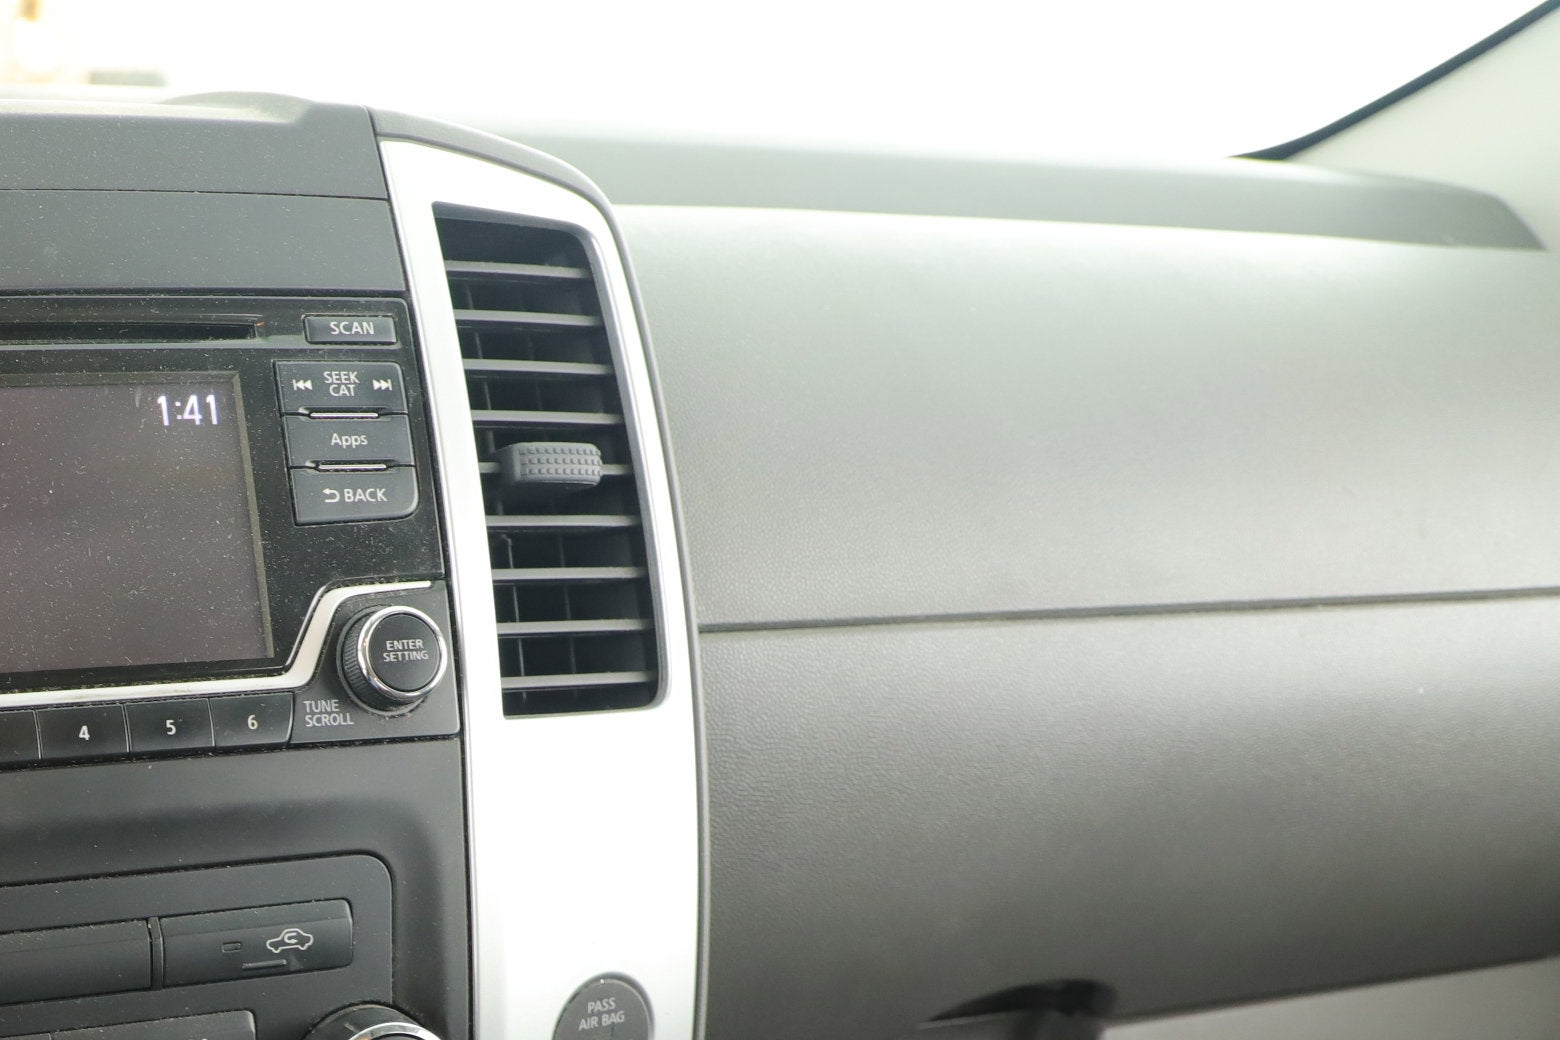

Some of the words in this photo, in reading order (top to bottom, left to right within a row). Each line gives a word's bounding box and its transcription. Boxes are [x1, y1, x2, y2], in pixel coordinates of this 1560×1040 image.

[329, 321, 375, 336] SCAN
[323, 371, 359, 384] SEEK
[329, 384, 356, 397] CAT
[156, 393, 219, 426] 1:41
[330, 432, 368, 448] Apps
[344, 488, 388, 503] BACK
[385, 637, 424, 651] ENTER
[383, 649, 429, 663] SETTING
[304, 700, 340, 713] TUNE
[165, 719, 177, 735] 5
[247, 713, 258, 730] 6
[305, 711, 354, 727] SCROLL
[77, 724, 91, 742] 4
[587, 997, 616, 1014] PASS
[578, 1016, 599, 1032] AIR
[601, 1010, 625, 1027] BAG
